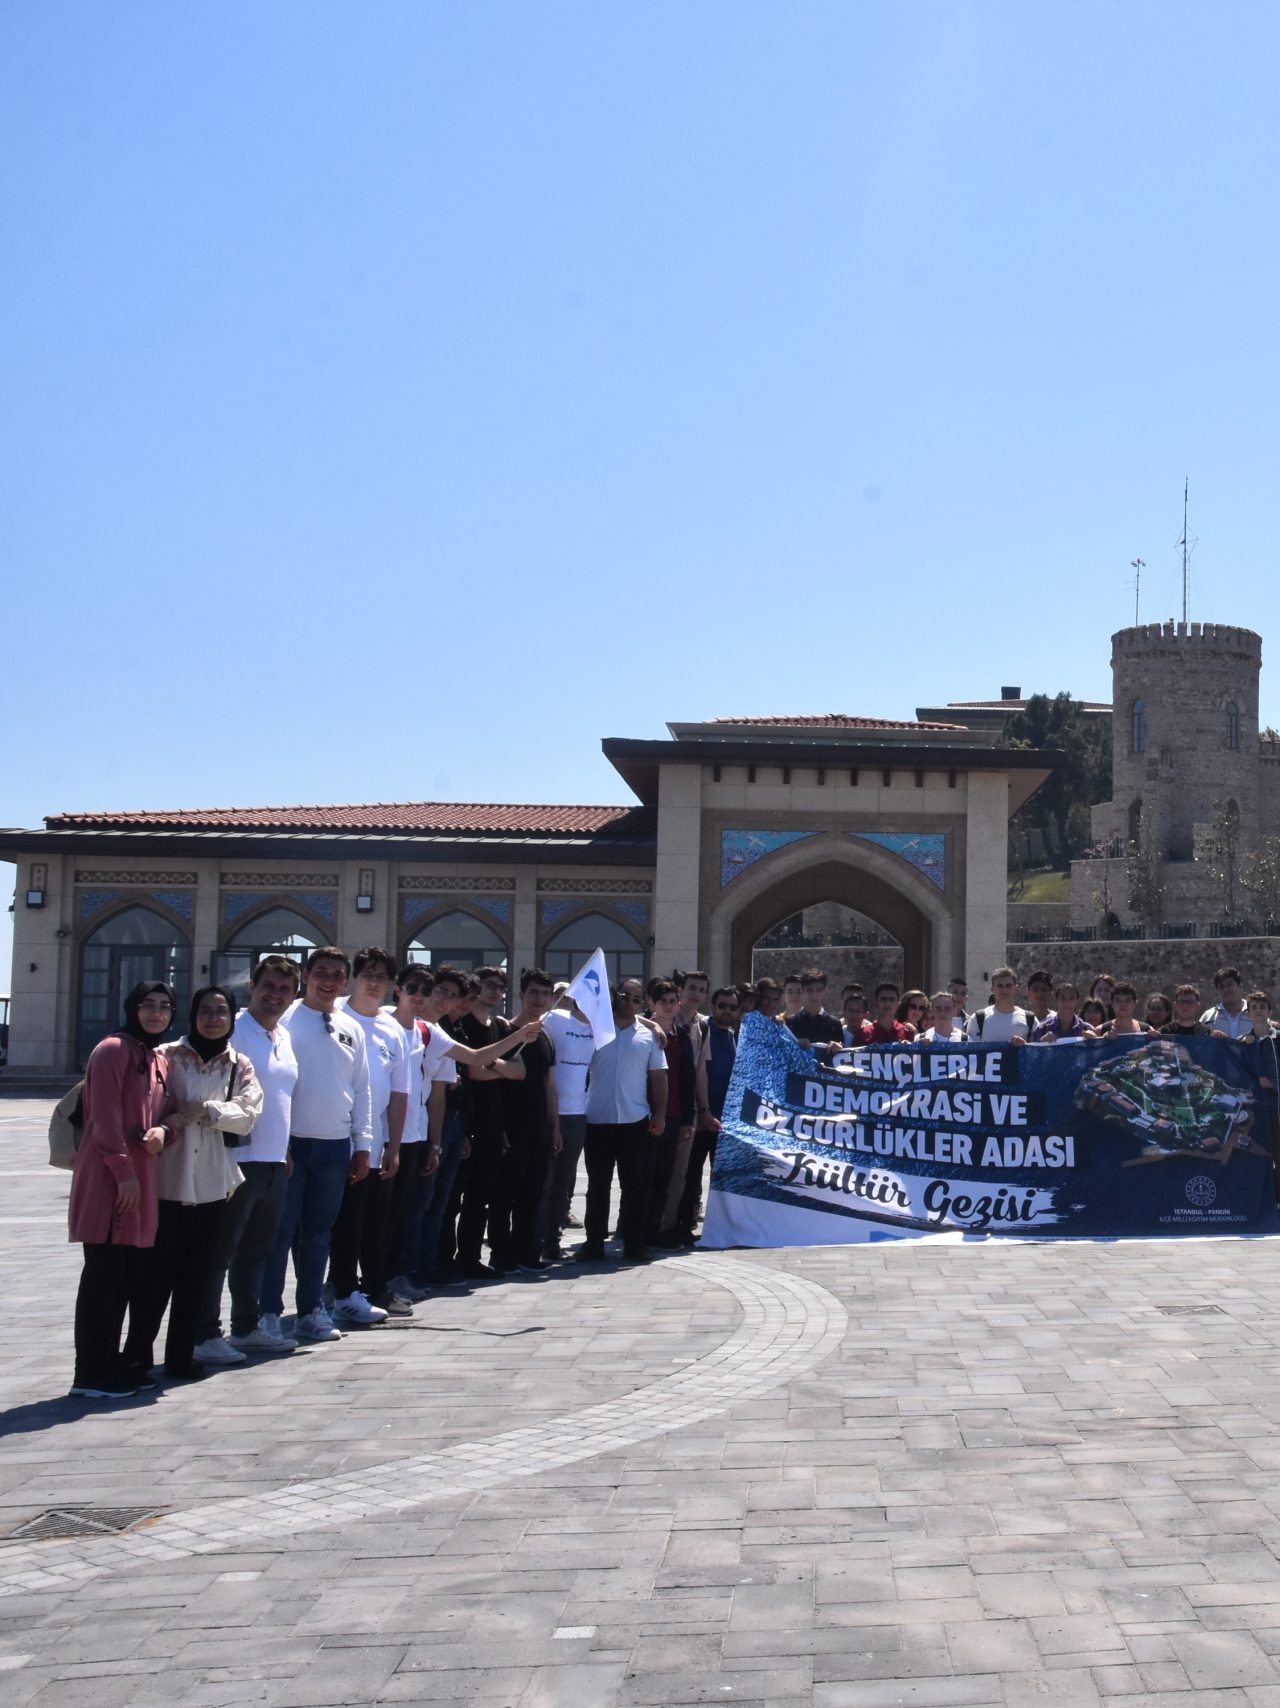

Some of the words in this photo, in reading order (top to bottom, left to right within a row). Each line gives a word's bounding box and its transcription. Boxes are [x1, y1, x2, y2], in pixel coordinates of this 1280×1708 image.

[989, 1094, 1027, 1125] VE
[980, 1135, 1075, 1167] ADASI
[780, 1152, 912, 1207] Kültür
[923, 1180, 1038, 1228] Gezisi
